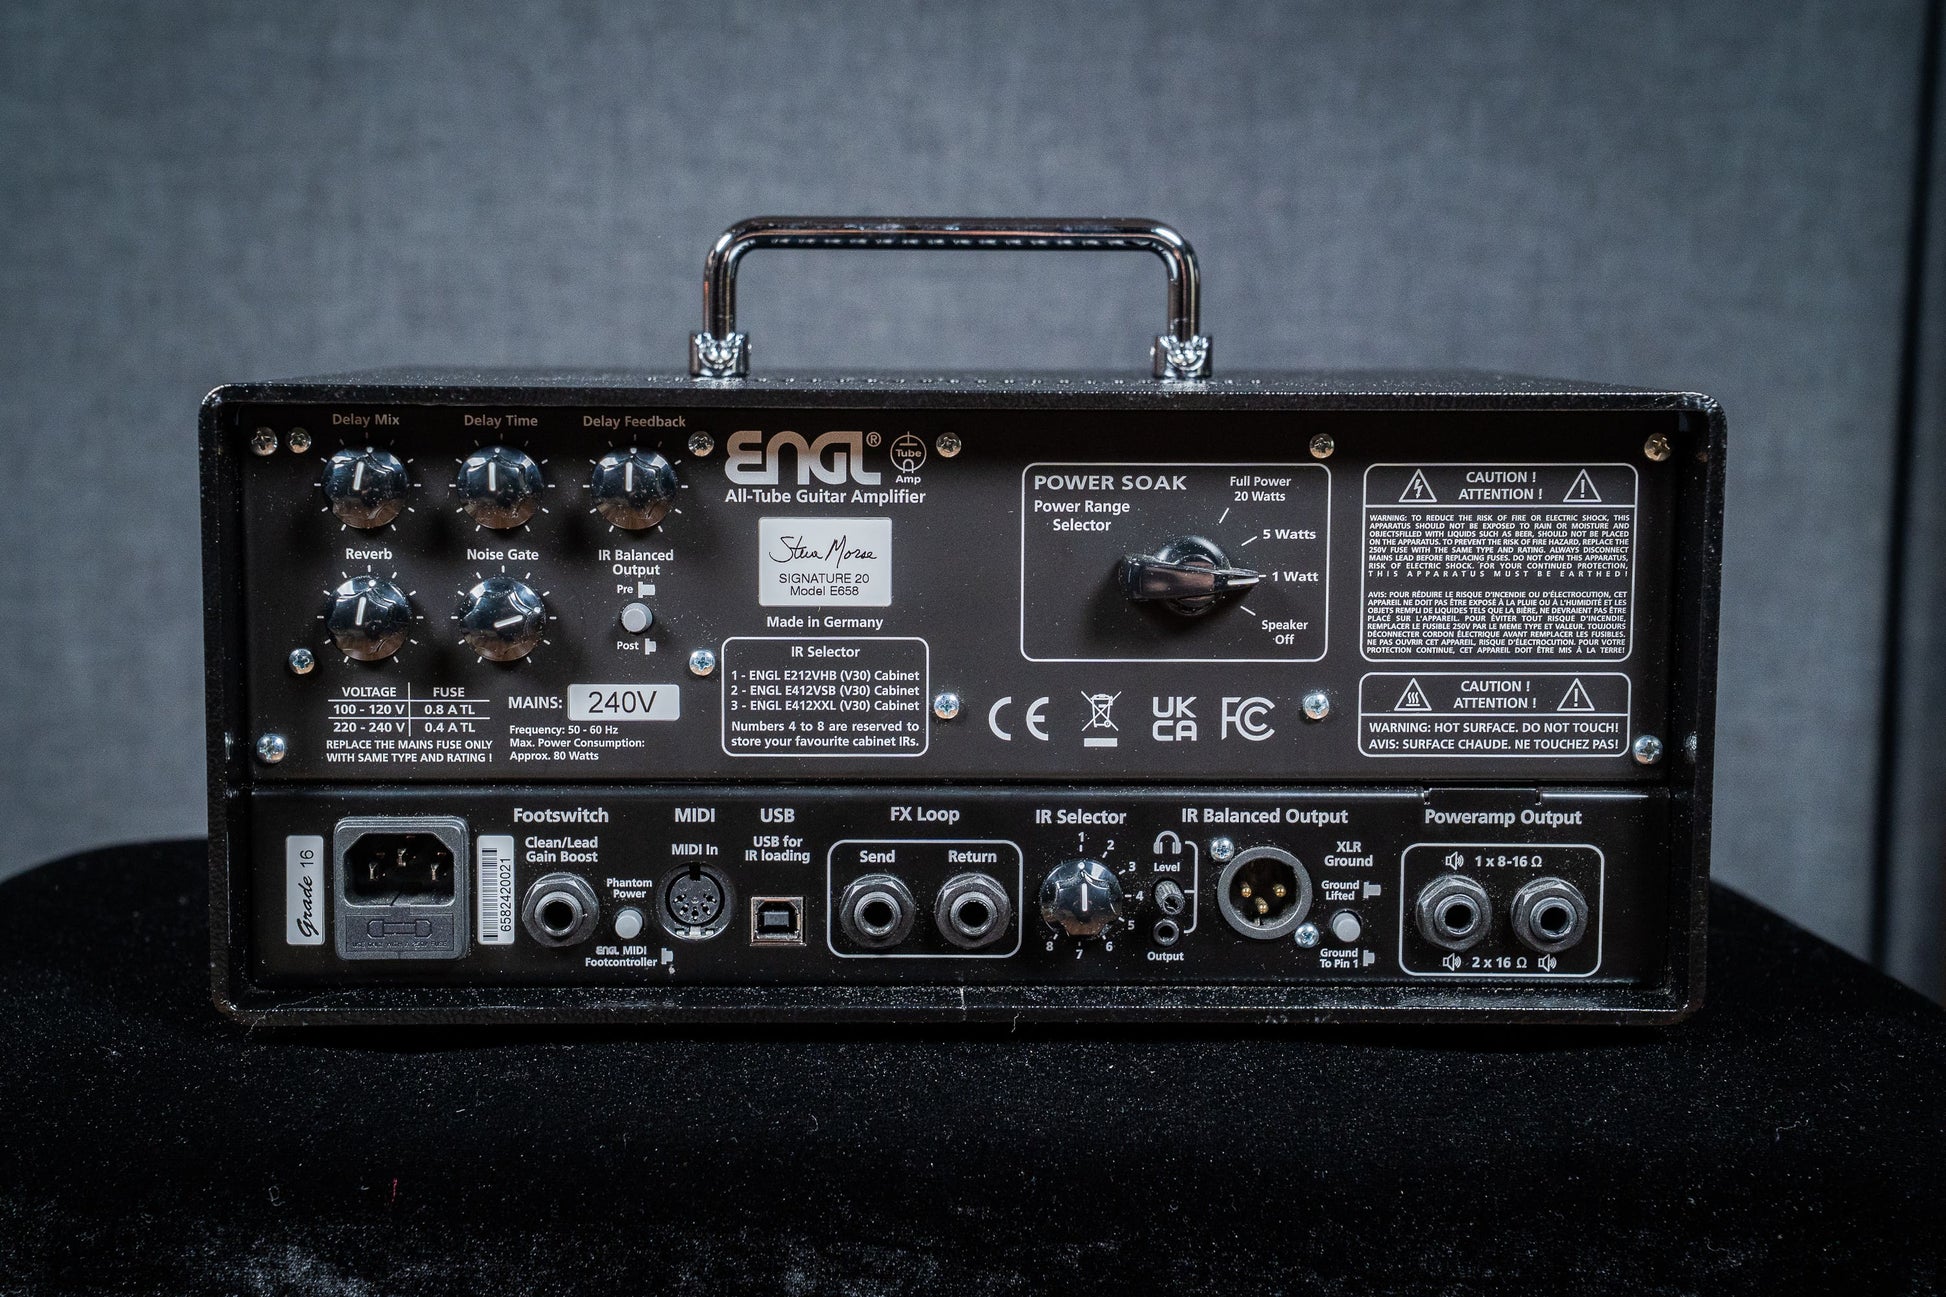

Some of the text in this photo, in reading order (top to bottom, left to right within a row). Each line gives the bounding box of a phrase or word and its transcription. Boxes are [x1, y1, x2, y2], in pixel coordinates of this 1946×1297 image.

[333, 413, 400, 428] Delay Mix
[464, 414, 538, 429] Delay Time
[583, 415, 686, 430] Delay Feedback
[895, 449, 922, 457] Tube
[895, 475, 921, 485] Amp
[1034, 475, 1187, 490] POWER SOAK
[1230, 475, 1292, 486] Full Power
[1466, 472, 1527, 483] CAUTION
[725, 488, 926, 507] All-Tube Guitar Amplifier
[1234, 491, 1286, 501] 20 Watts
[1458, 488, 1533, 500] ATTENTION
[1034, 500, 1130, 516] Power Range
[1053, 518, 1111, 531] Selector
[346, 546, 393, 560] Reverb
[467, 548, 539, 560] Noise Gate
[599, 549, 674, 561] IR Balanced
[613, 564, 660, 578] Output
[1272, 571, 1319, 582] 1 Watt
[779, 573, 869, 584] SIGNATURE 20
[617, 584, 633, 594] Pre
[790, 585, 859, 596] Model E658
[767, 616, 883, 630] Made in Germany
[1262, 619, 1308, 632] Speaker
[1275, 634, 1295, 645] Off
[1367, 630, 1420, 638] DÉCONNECTER
[1457, 630, 1500, 638] ÉLECTRIQUE
[617, 641, 639, 650] Post
[791, 645, 860, 657] IR Selector
[732, 670, 737, 680] 1
[749, 670, 781, 680] ENGL
[784, 670, 837, 680] E212VHB
[840, 670, 871, 682] (V30)
[874, 670, 920, 681] Cabinet
[342, 687, 396, 697] VOLTAGE
[433, 687, 465, 697] FUSE
[508, 696, 562, 709] MAINS:
[589, 691, 657, 713] 240V
[334, 704, 356, 714] 100
[369, 704, 392, 715] 120
[395, 704, 405, 715] V
[988, 696, 1049, 741] CE
[732, 720, 919, 731] Numbers 4 to 8 are reserved to
[1369, 722, 1618, 733] WARNING: HOT SURFACE. DO NOT TOUCH!
[326, 740, 493, 749] REPLACE THE MAINS FUSE ONLY
[510, 738, 645, 749] Max. Power Consumption:
[1369, 739, 1618, 749] AVIS: SURFACE CHAUDE. NE TOUCHEZ PAS!
[509, 751, 599, 762] Approx. 80 Watts
[514, 807, 609, 823] Footswitch
[675, 808, 715, 822] MIDI
[760, 808, 795, 823] USB
[891, 806, 960, 825] FX Loop
[1182, 807, 1348, 826] IR Balanced Output
[1425, 809, 1582, 828] Poweramp Output
[525, 836, 598, 848] Clean/Lead
[1336, 841, 1361, 853] XLR
[672, 844, 718, 855] MIDI In
[526, 850, 598, 865] Gain Boost
[745, 849, 810, 864] IR loading
[860, 849, 895, 863] Send
[948, 850, 997, 863] Return
[1324, 854, 1373, 867] Ground
[1154, 862, 1180, 872] Level
[607, 877, 652, 887] Phantom
[296, 850, 319, 937] Grade 16
[500, 859, 512, 932] 6582420021
[613, 889, 646, 900] Power
[595, 946, 647, 955] ENGL MIDI
[585, 957, 658, 967] Footcontroller
[1147, 951, 1184, 963] Output
